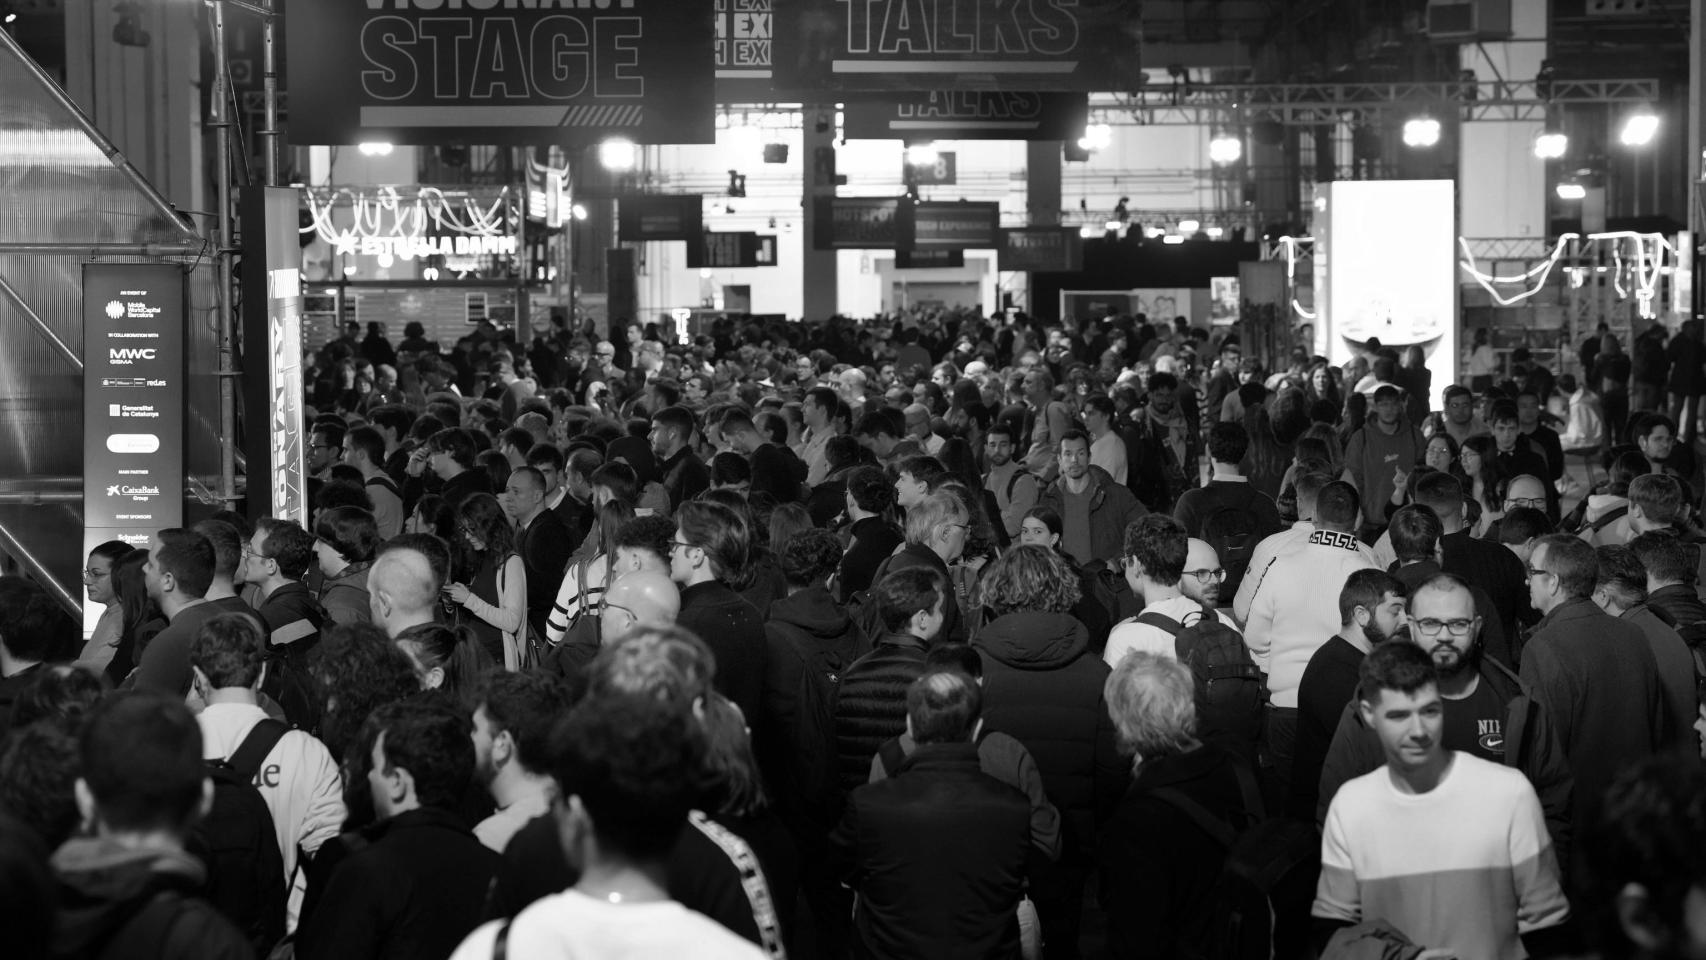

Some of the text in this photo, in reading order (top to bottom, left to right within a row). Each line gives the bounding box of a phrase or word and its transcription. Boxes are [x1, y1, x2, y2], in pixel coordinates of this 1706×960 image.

[733, 13, 773, 39] EX
[835, 0, 1079, 54] TALKS
[360, 15, 645, 100] STAGE
[733, 40, 772, 65] EX
[455, 236, 516, 254] DAMM
[109, 348, 156, 360] MWC
[121, 485, 160, 494] CaixaBank
